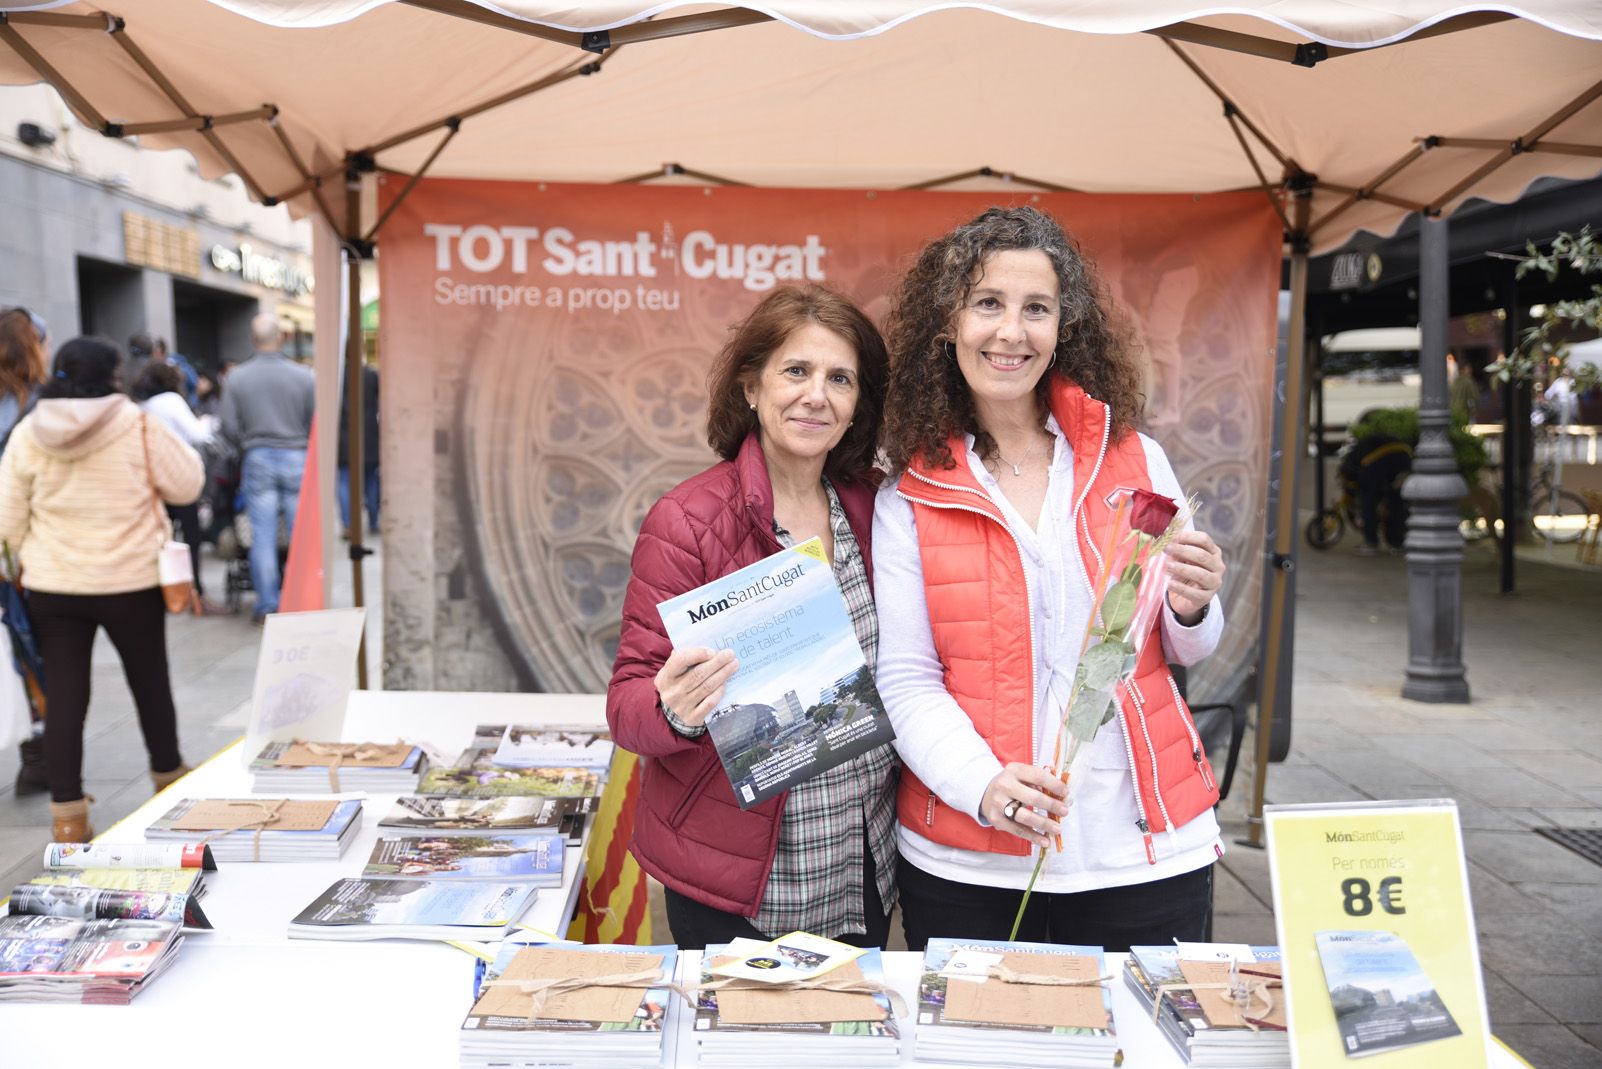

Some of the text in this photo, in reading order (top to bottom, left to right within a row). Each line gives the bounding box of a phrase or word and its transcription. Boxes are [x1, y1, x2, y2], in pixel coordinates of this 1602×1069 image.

[424, 223, 827, 291] TOT Sant Cugat
[434, 278, 680, 314] Sempre a prop teu
[686, 562, 805, 624] MónSantCugat
[714, 634, 735, 651] Un
[736, 604, 805, 642] ecosistema
[739, 626, 794, 659] de talent
[852, 714, 874, 731] GREEN
[1325, 829, 1405, 845] MónSantCugat
[1332, 854, 1405, 870] Per només
[1341, 876, 1406, 917] 8€
